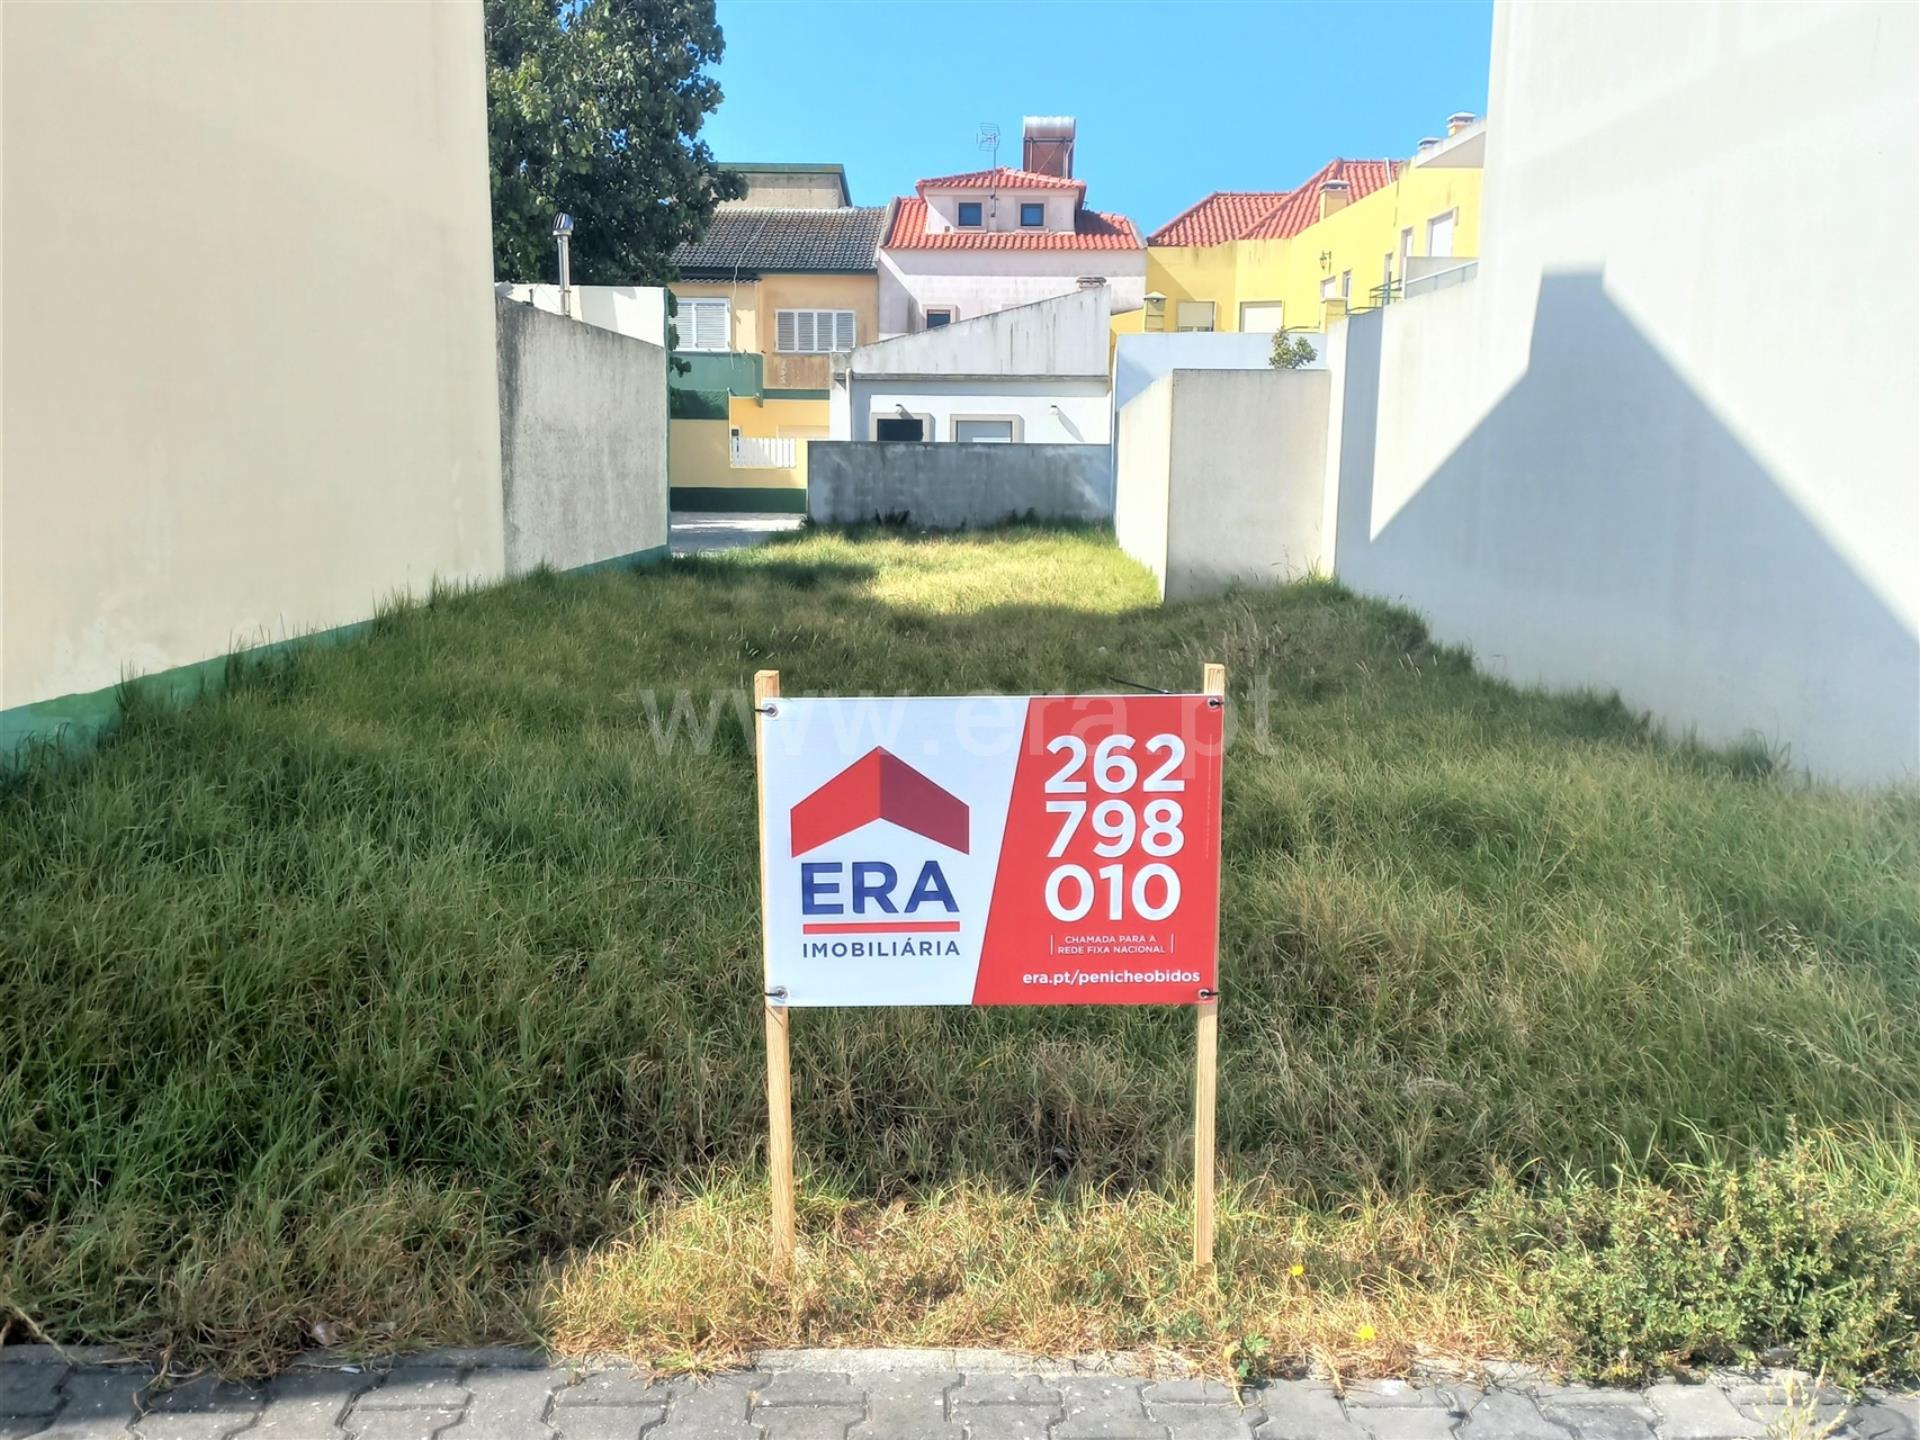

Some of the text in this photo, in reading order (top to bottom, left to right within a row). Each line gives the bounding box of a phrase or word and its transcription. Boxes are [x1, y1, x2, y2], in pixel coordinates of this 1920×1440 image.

[1043, 733, 1186, 794] 262
[1044, 798, 1185, 859] 798
[800, 859, 960, 916] ERA
[1043, 862, 1182, 922] 010
[802, 937, 961, 959] IMOBILIÁRIA
[1057, 944, 1166, 955] REDE FIXA NACIONAL
[1064, 934, 1156, 944] CHAMADA PARA A
[1022, 969, 1201, 986] era.pt/penicheobidos
